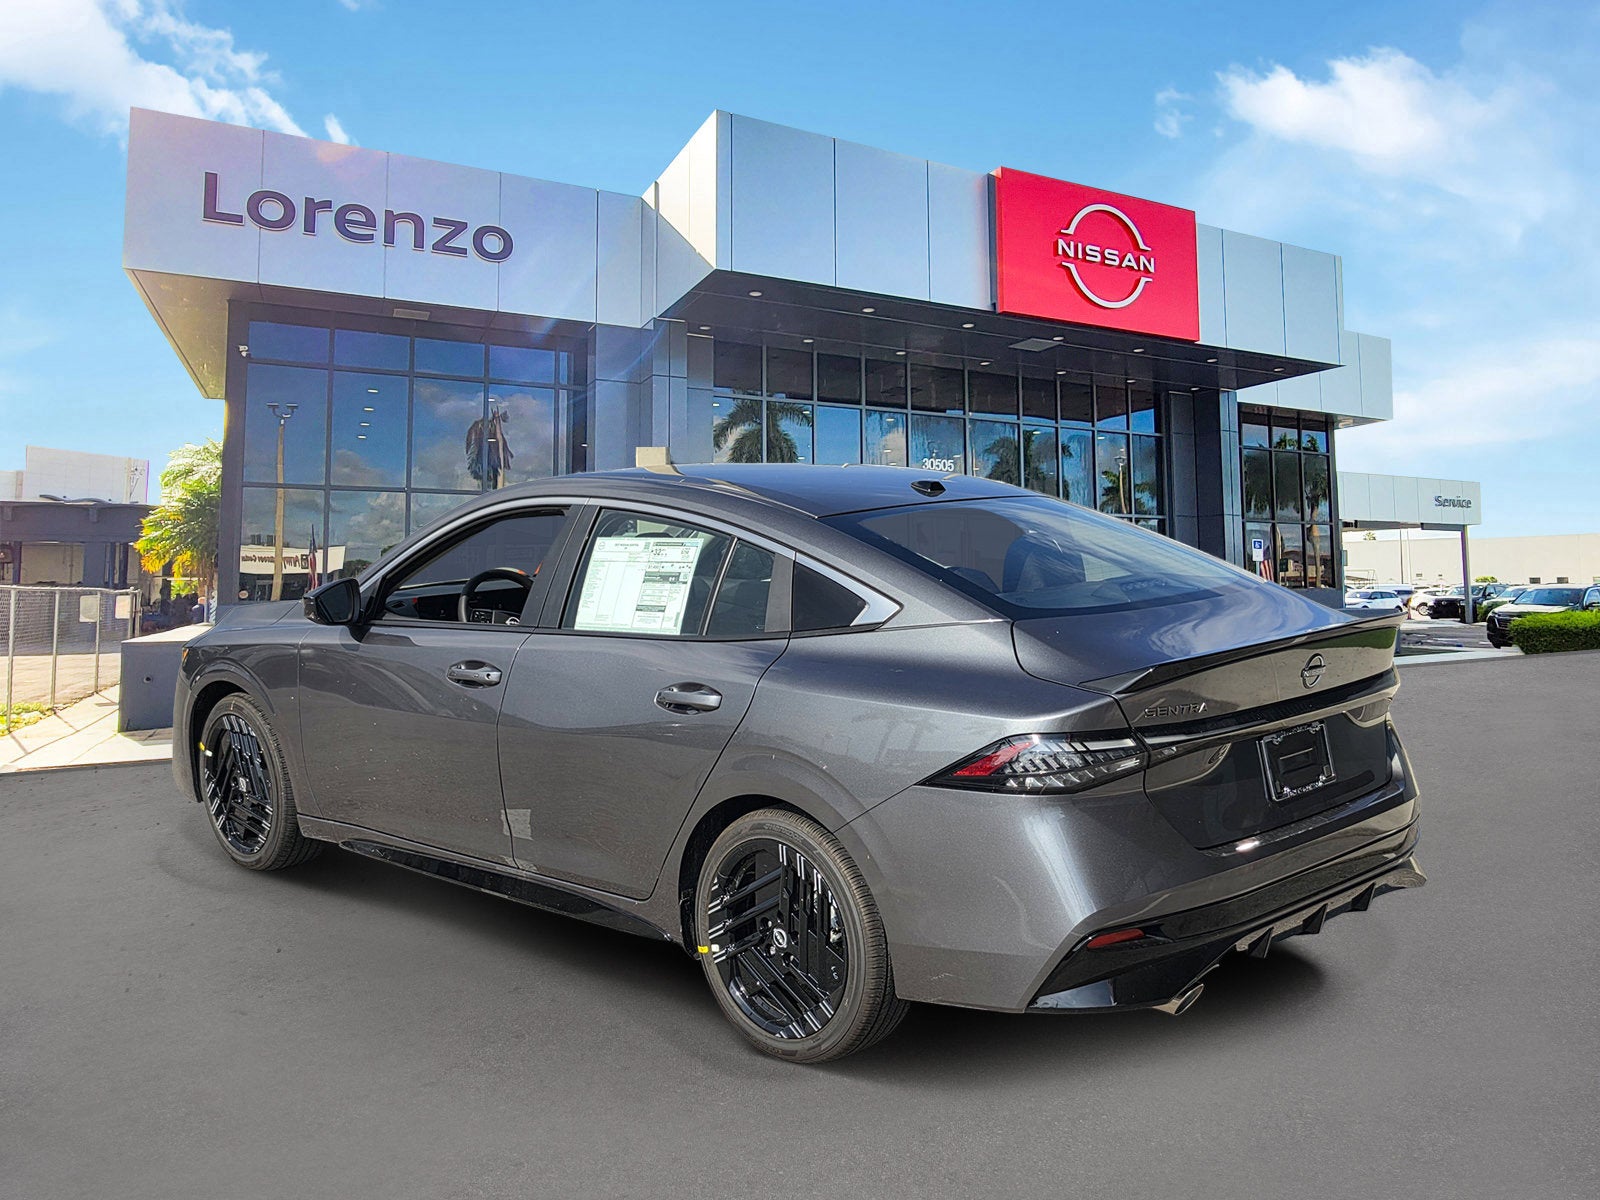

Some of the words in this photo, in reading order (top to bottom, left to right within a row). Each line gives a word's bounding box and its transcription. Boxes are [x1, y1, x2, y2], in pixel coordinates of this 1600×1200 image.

[202, 170, 514, 263] Lorenzo
[1057, 238, 1155, 273] NISSAN
[922, 458, 955, 471] 30505
[1434, 495, 1472, 508] Service
[1144, 702, 1208, 718] SENTRA
